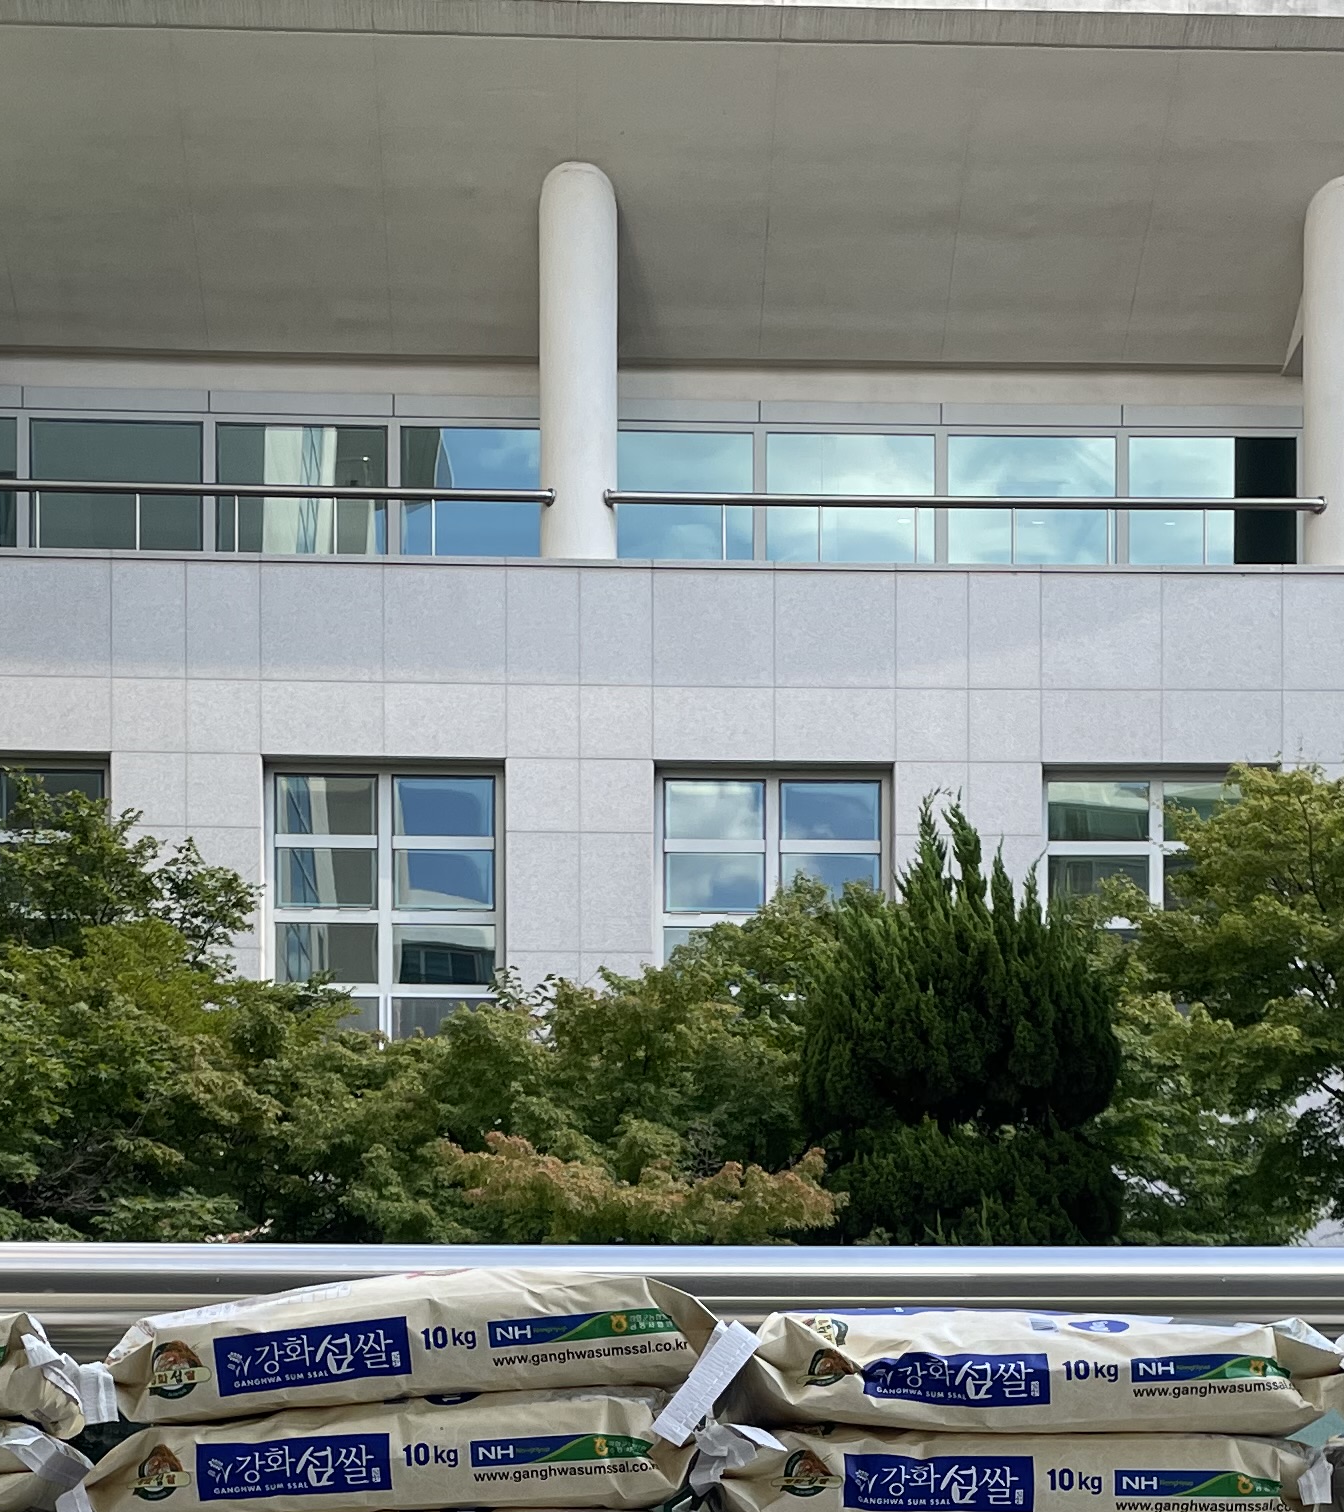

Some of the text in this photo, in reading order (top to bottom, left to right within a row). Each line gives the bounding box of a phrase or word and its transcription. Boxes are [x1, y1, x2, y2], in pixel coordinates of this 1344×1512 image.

[254, 1330, 397, 1374] 강화섬쌀
[496, 1325, 532, 1341] NH
[492, 1339, 688, 1369] www.ganghwasumssal.co.kr
[234, 1370, 328, 1388] GANGHWA SUM SSAL
[235, 1445, 377, 1486] 강화섬쌀
[478, 1444, 514, 1461] NH
